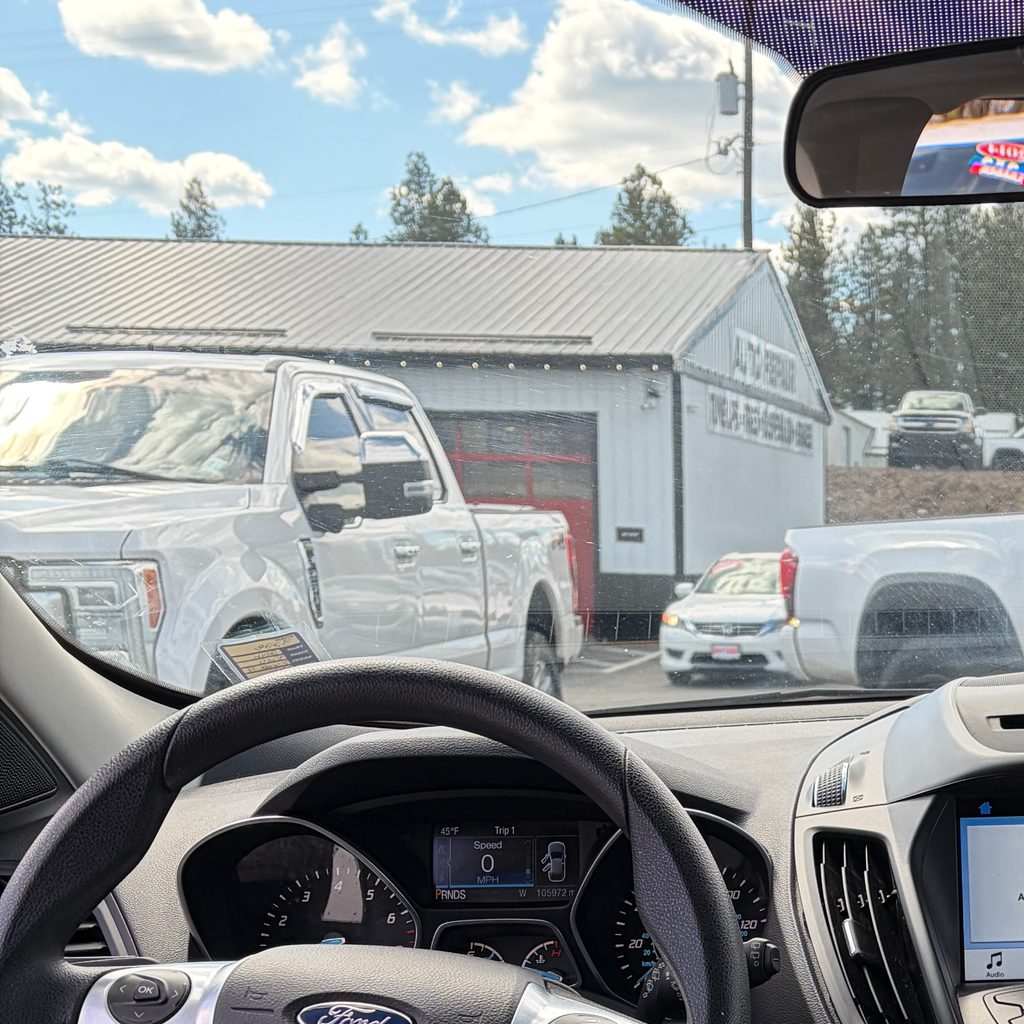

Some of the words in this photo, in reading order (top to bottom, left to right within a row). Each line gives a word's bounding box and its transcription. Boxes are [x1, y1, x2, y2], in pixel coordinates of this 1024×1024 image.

[440, 826, 459, 836] 45°F
[494, 826, 510, 836] Trip
[511, 826, 515, 835] 1
[473, 840, 502, 851] Speed
[481, 854, 494, 873] 0
[477, 875, 499, 884] MPH
[334, 880, 343, 892] 4
[302, 891, 311, 902] 3
[366, 889, 374, 900] 5
[435, 889, 466, 900] PRNDS
[519, 889, 527, 897] W
[537, 888, 567, 897] 105972
[278, 915, 287, 927] 2
[387, 913, 396, 924] 6
[740, 919, 758, 930] 120
[628, 939, 644, 949] 20
[138, 985, 154, 994] OK
